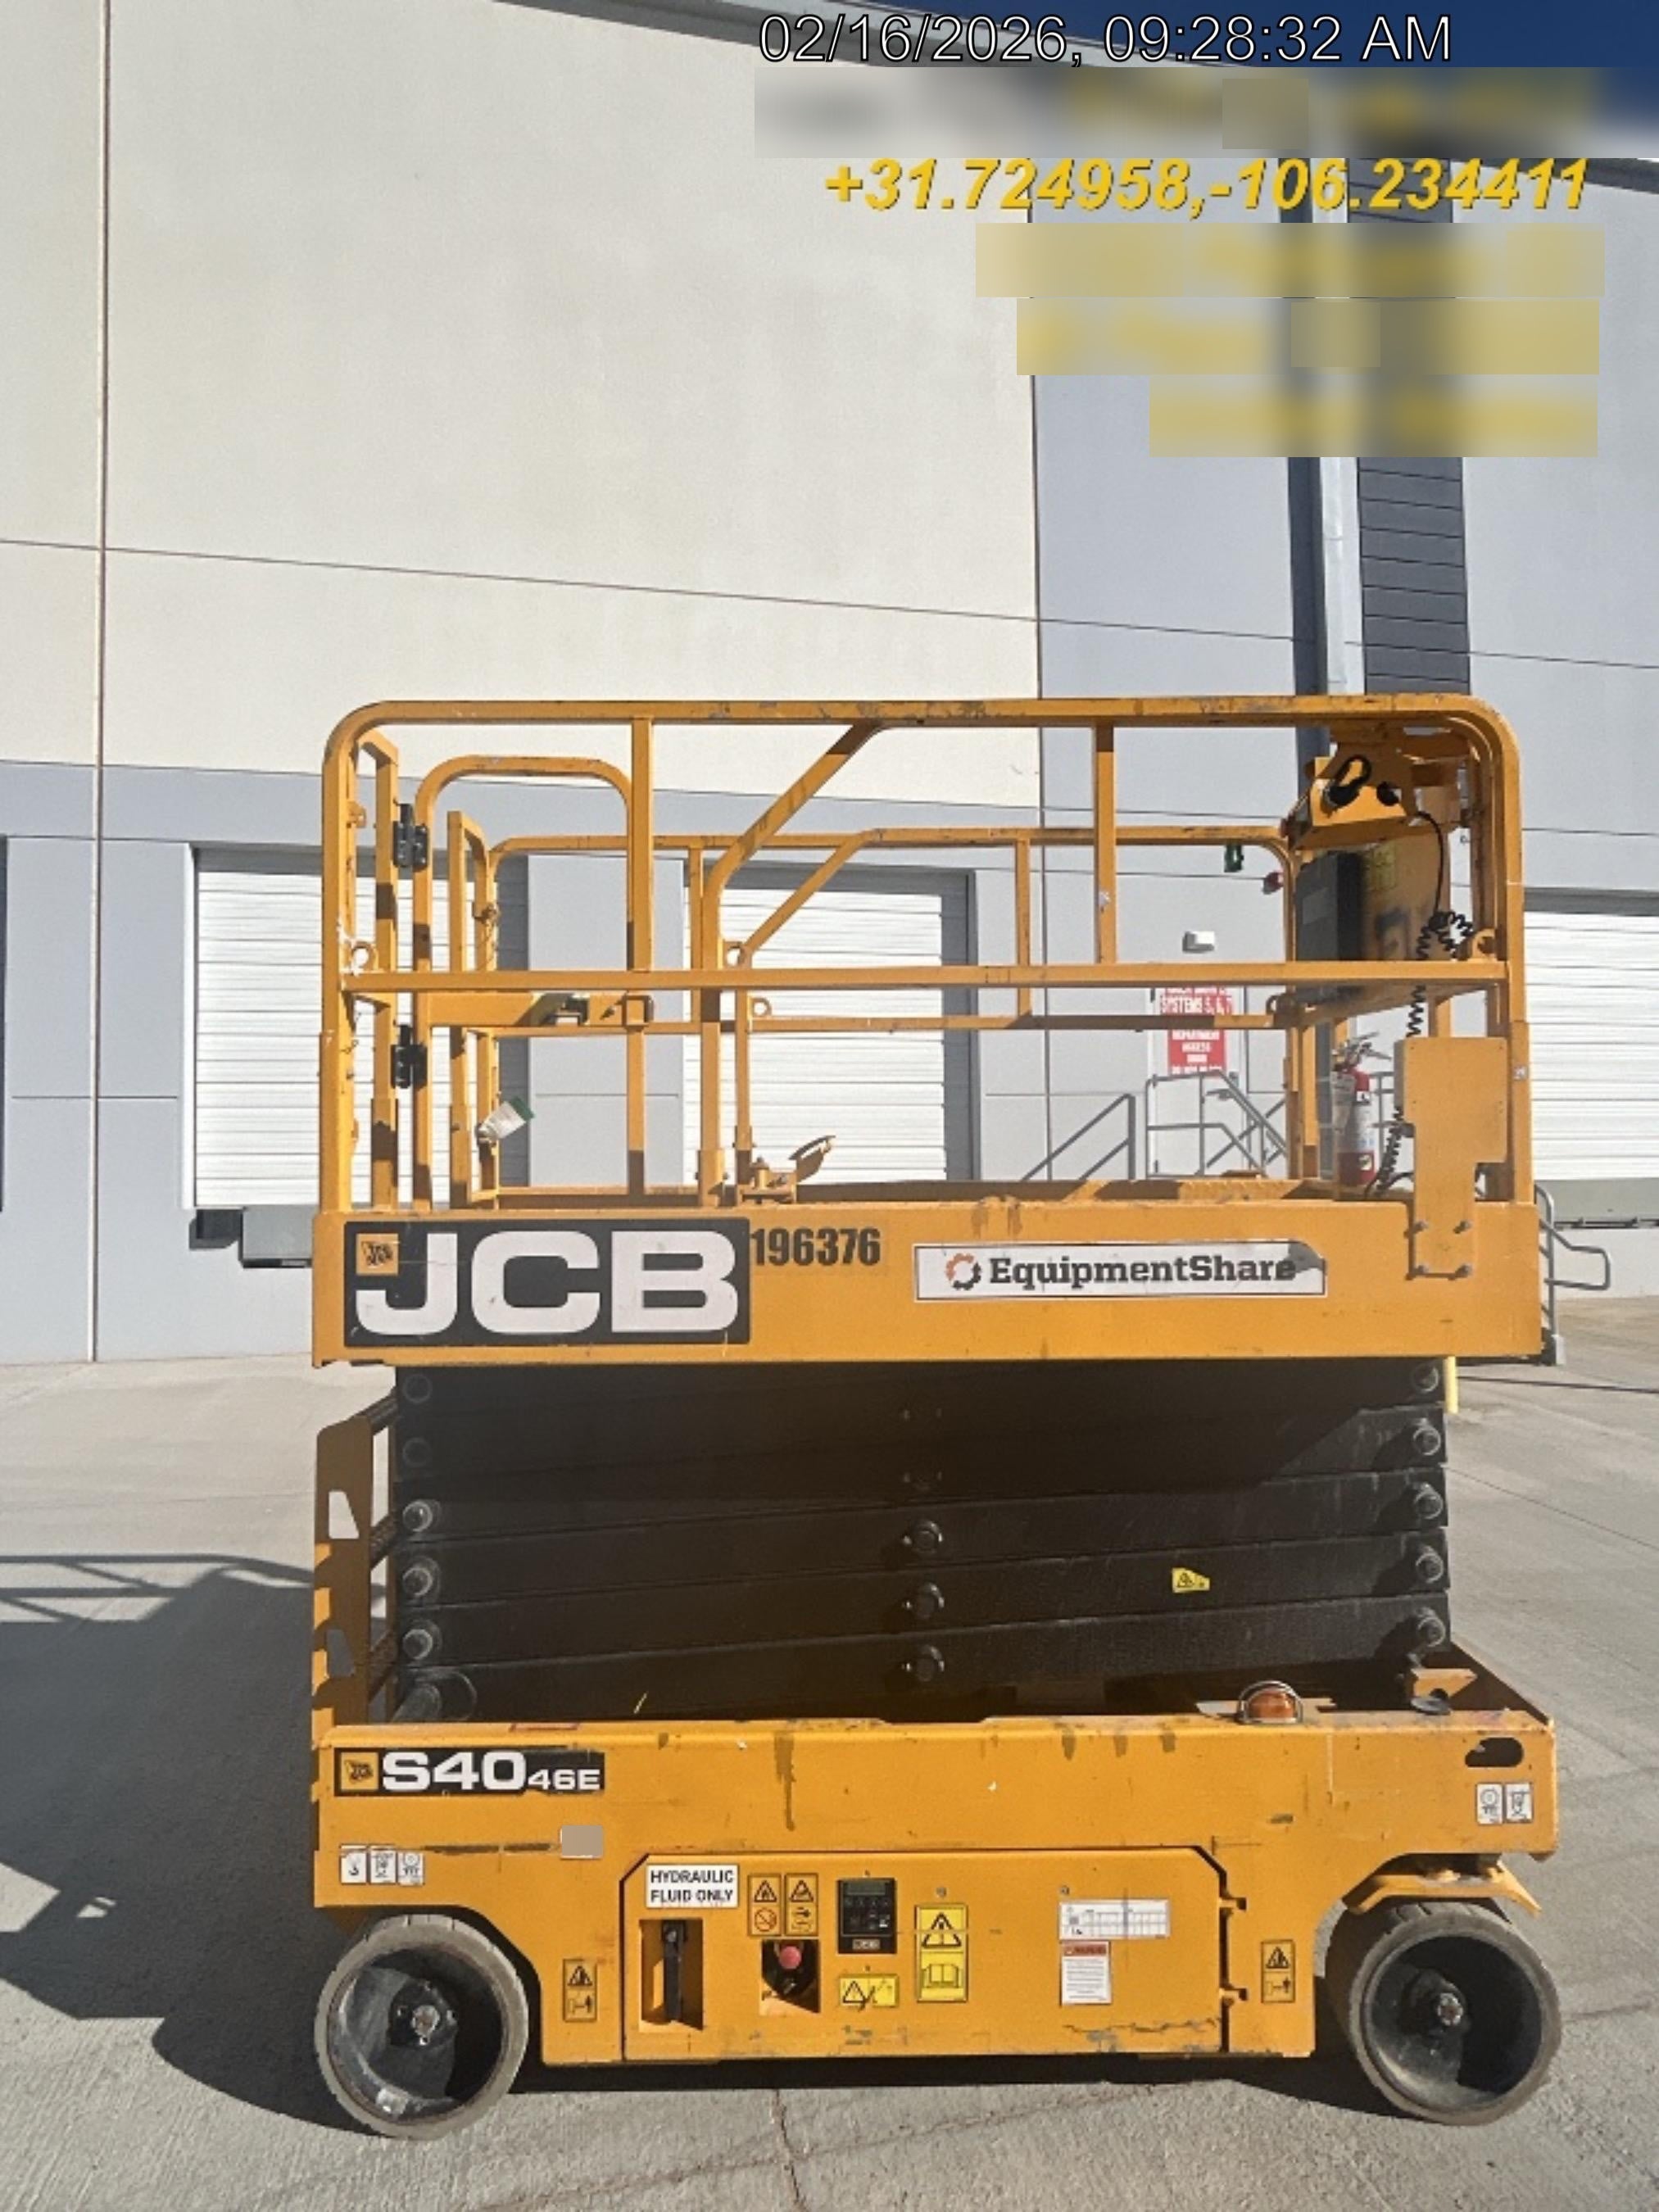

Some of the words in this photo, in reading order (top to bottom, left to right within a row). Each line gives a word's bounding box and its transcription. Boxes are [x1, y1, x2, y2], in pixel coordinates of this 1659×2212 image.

[750, 1228, 881, 1266] 196376
[356, 1231, 738, 1335] JCB
[989, 1255, 1296, 1289] EquipmentShare
[650, 1870, 734, 1883] HYDRAULIC
[651, 1888, 691, 1902] FLUID
[696, 1888, 733, 1902] ONLY
